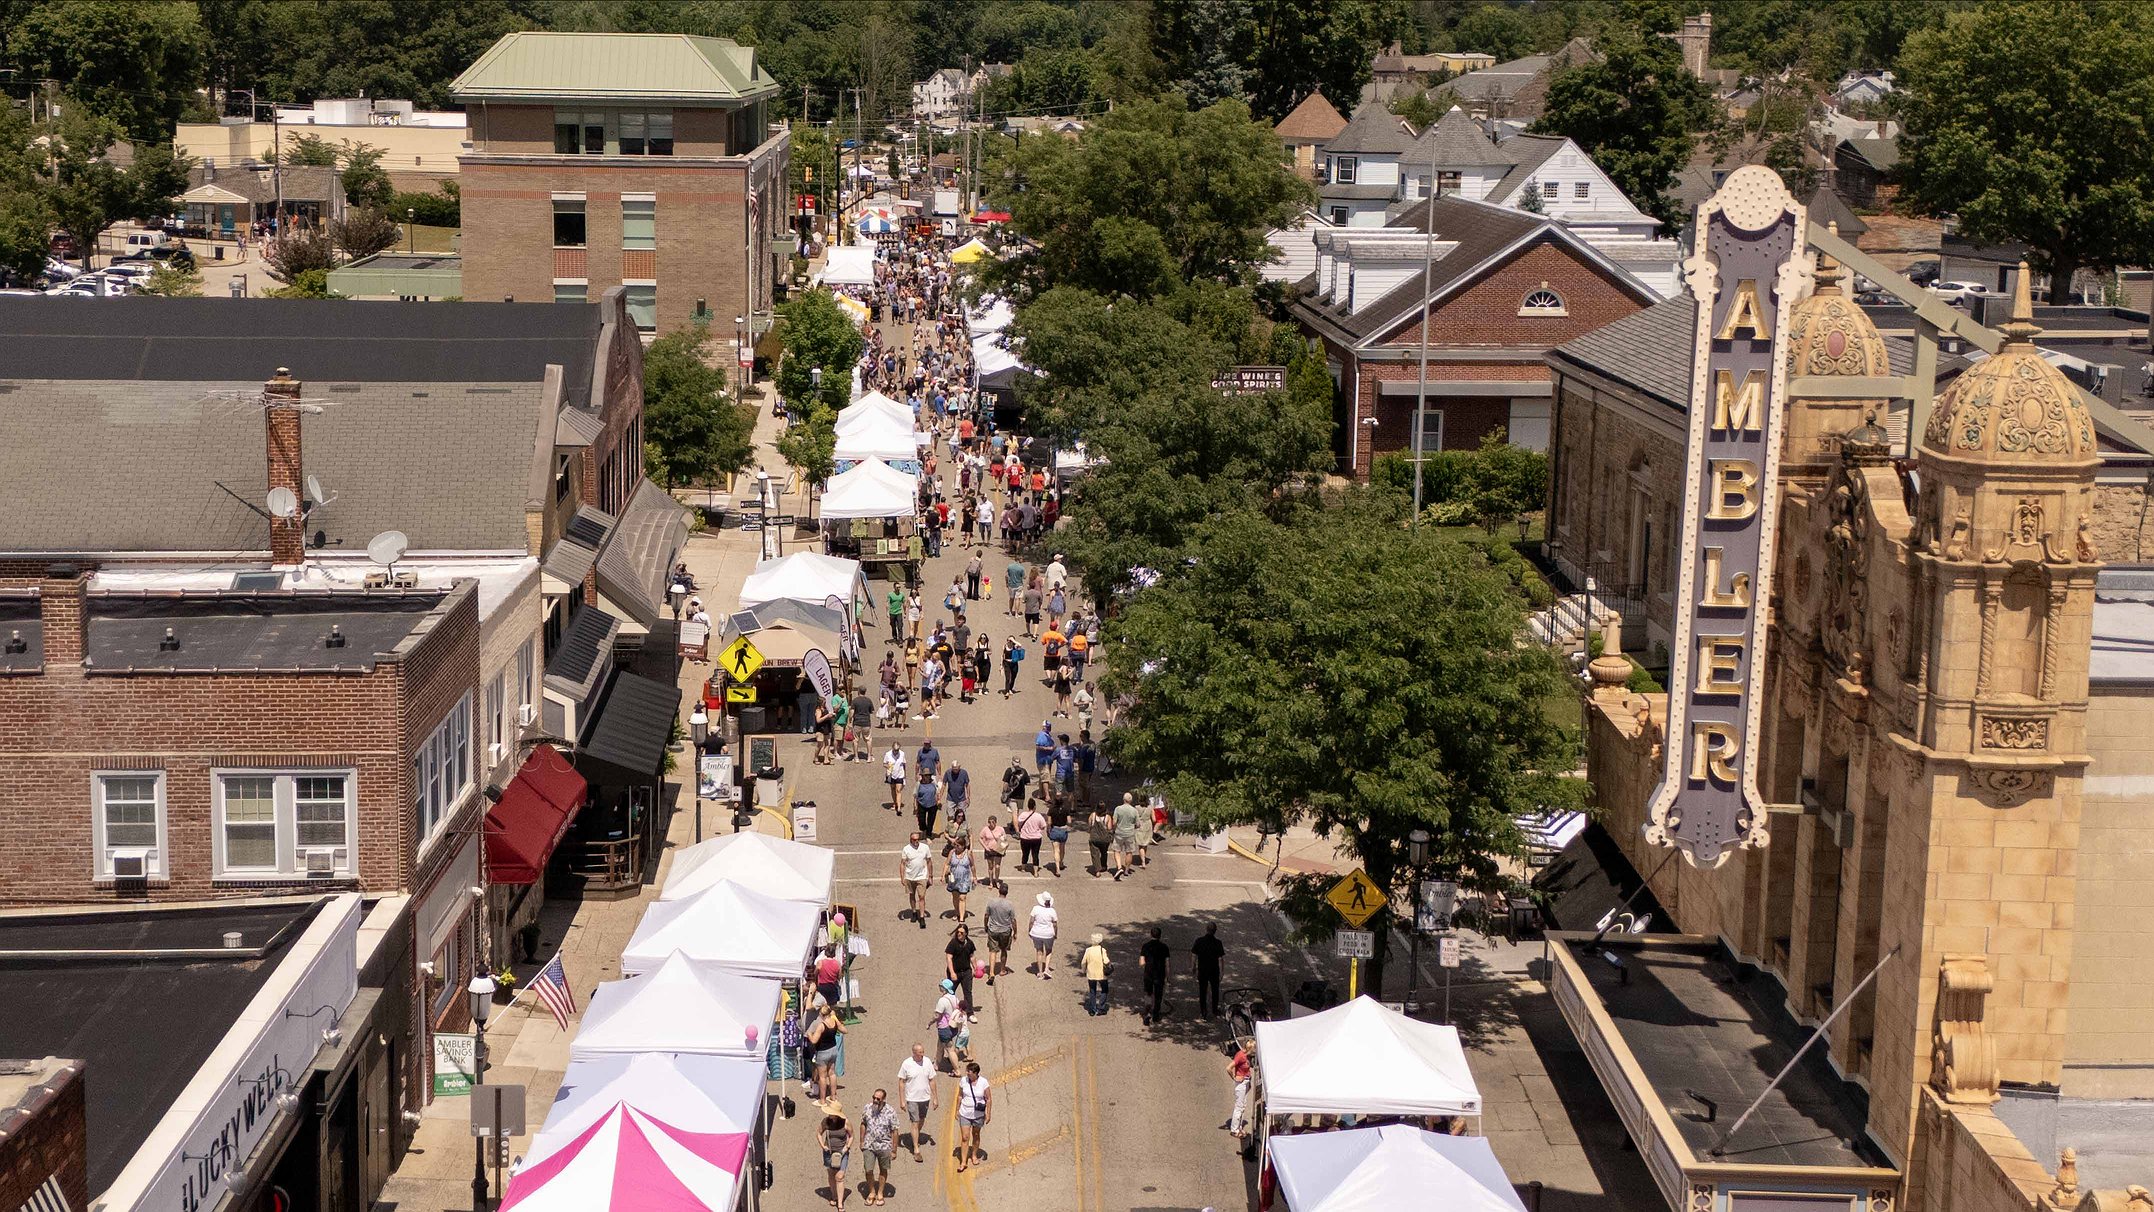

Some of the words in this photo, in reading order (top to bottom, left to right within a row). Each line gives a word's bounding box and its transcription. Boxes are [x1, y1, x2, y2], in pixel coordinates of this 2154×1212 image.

[1688, 278, 1771, 784] AMBLER
[815, 667, 831, 696] LAGER
[437, 1040, 472, 1048] AMBLER
[437, 1048, 472, 1056] SAVINGS
[444, 1055, 466, 1064] BANK
